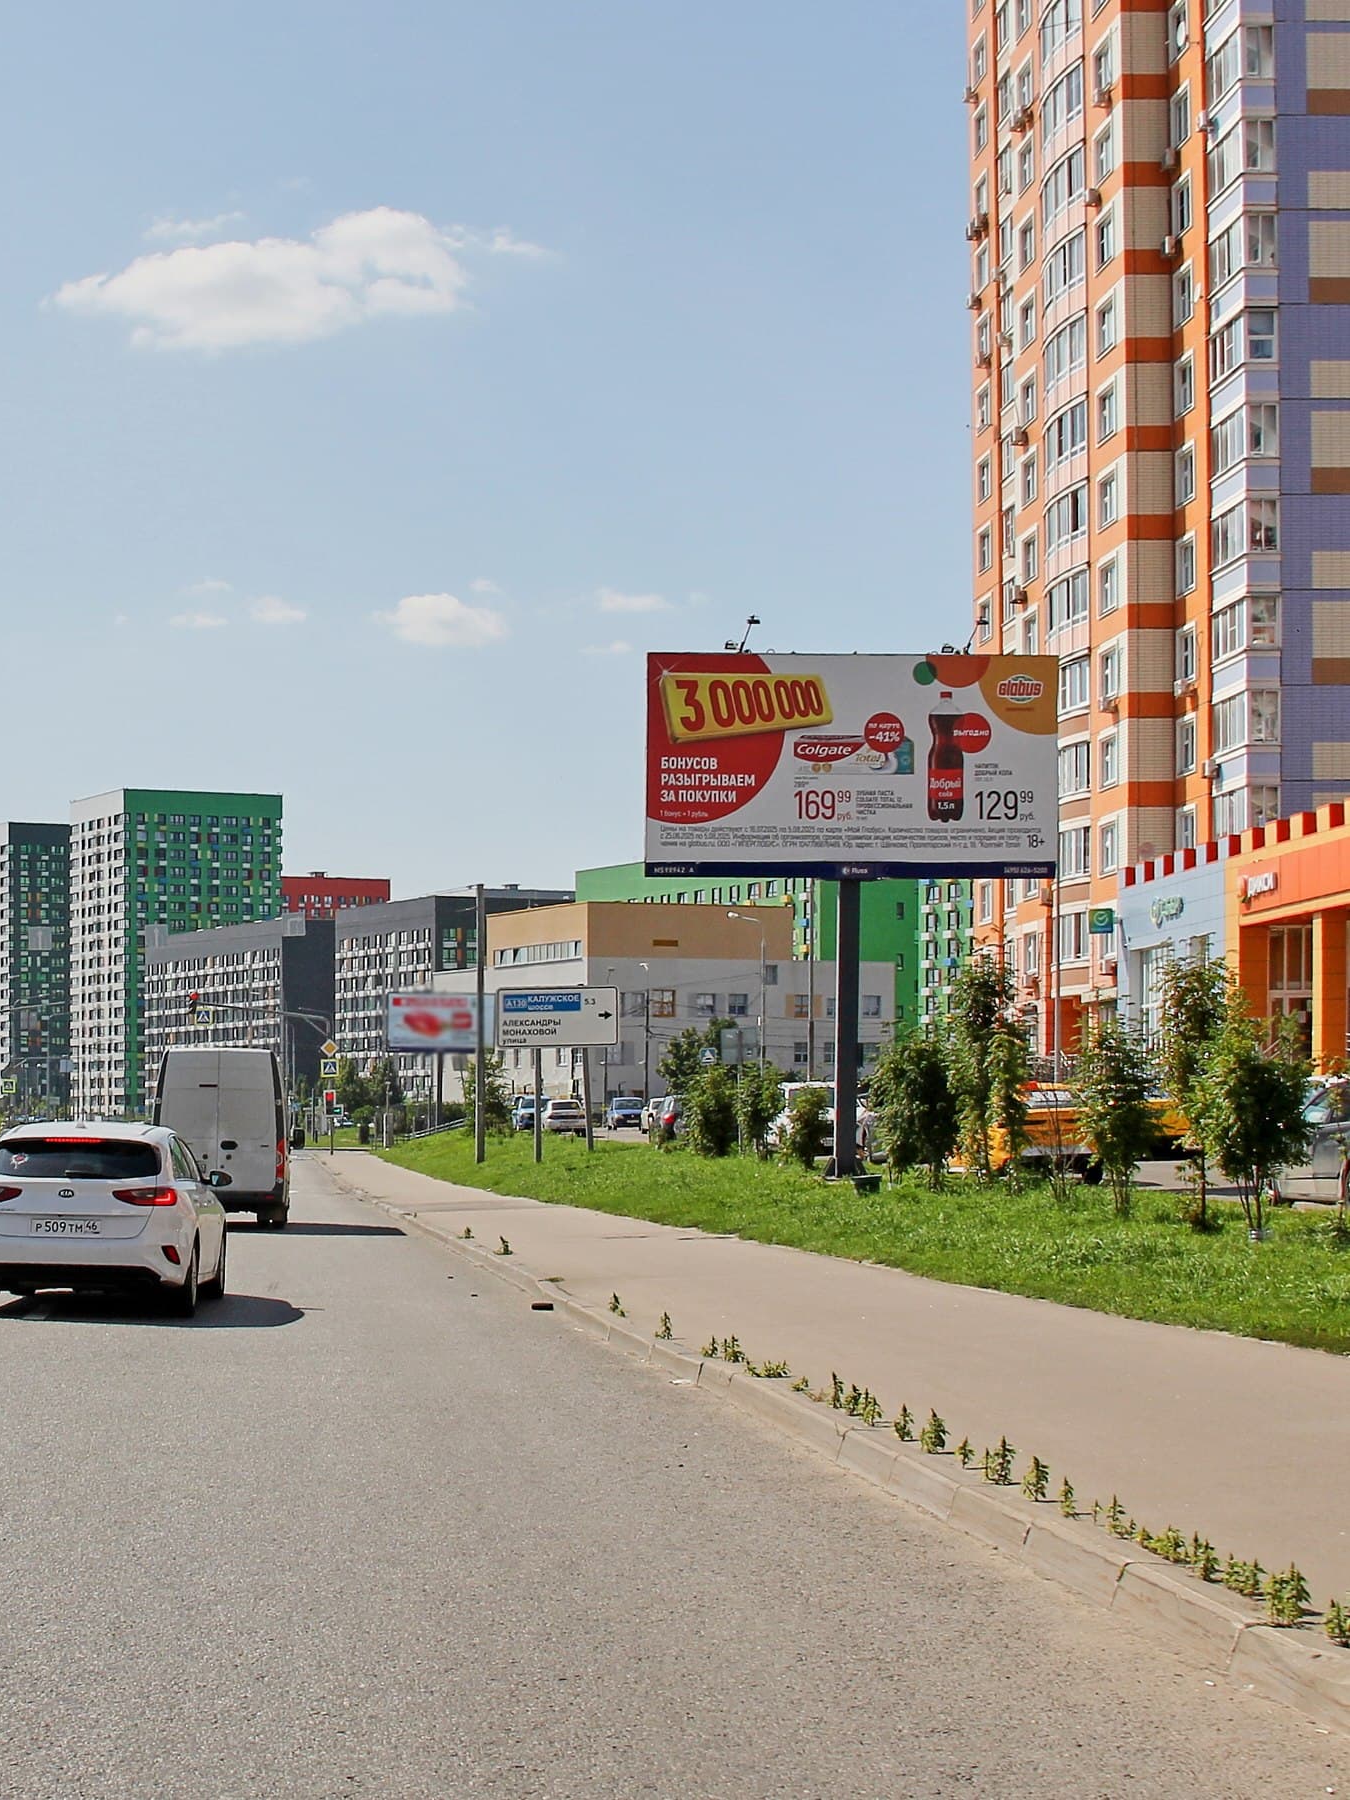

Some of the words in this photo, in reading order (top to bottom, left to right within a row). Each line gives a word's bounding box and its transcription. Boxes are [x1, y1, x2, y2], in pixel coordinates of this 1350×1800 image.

[675, 680, 706, 732] 3
[708, 679, 776, 728] 000
[774, 679, 824, 720] 000
[868, 731, 900, 743] -41%
[796, 744, 852, 757] Colgate
[660, 756, 718, 770] БОНУСОВ
[660, 773, 756, 787] РАЗЫГРЫВАЕМ
[660, 790, 676, 803] ЗА
[678, 790, 737, 803] ПОКУПКИ
[794, 789, 836, 820] 169
[836, 790, 851, 803] 99
[975, 790, 1018, 820] 129
[1019, 790, 1034, 803] 99
[1019, 813, 1035, 821] руб.
[1027, 834, 1045, 848] 18+
[527, 994, 580, 1003] КАЛУЖСКОЕ
[502, 1019, 562, 1027] АЛЕКСАНДРЫ
[502, 1028, 557, 1036] МОНАХОВОЙ
[85, 1220, 98, 1231] 46
